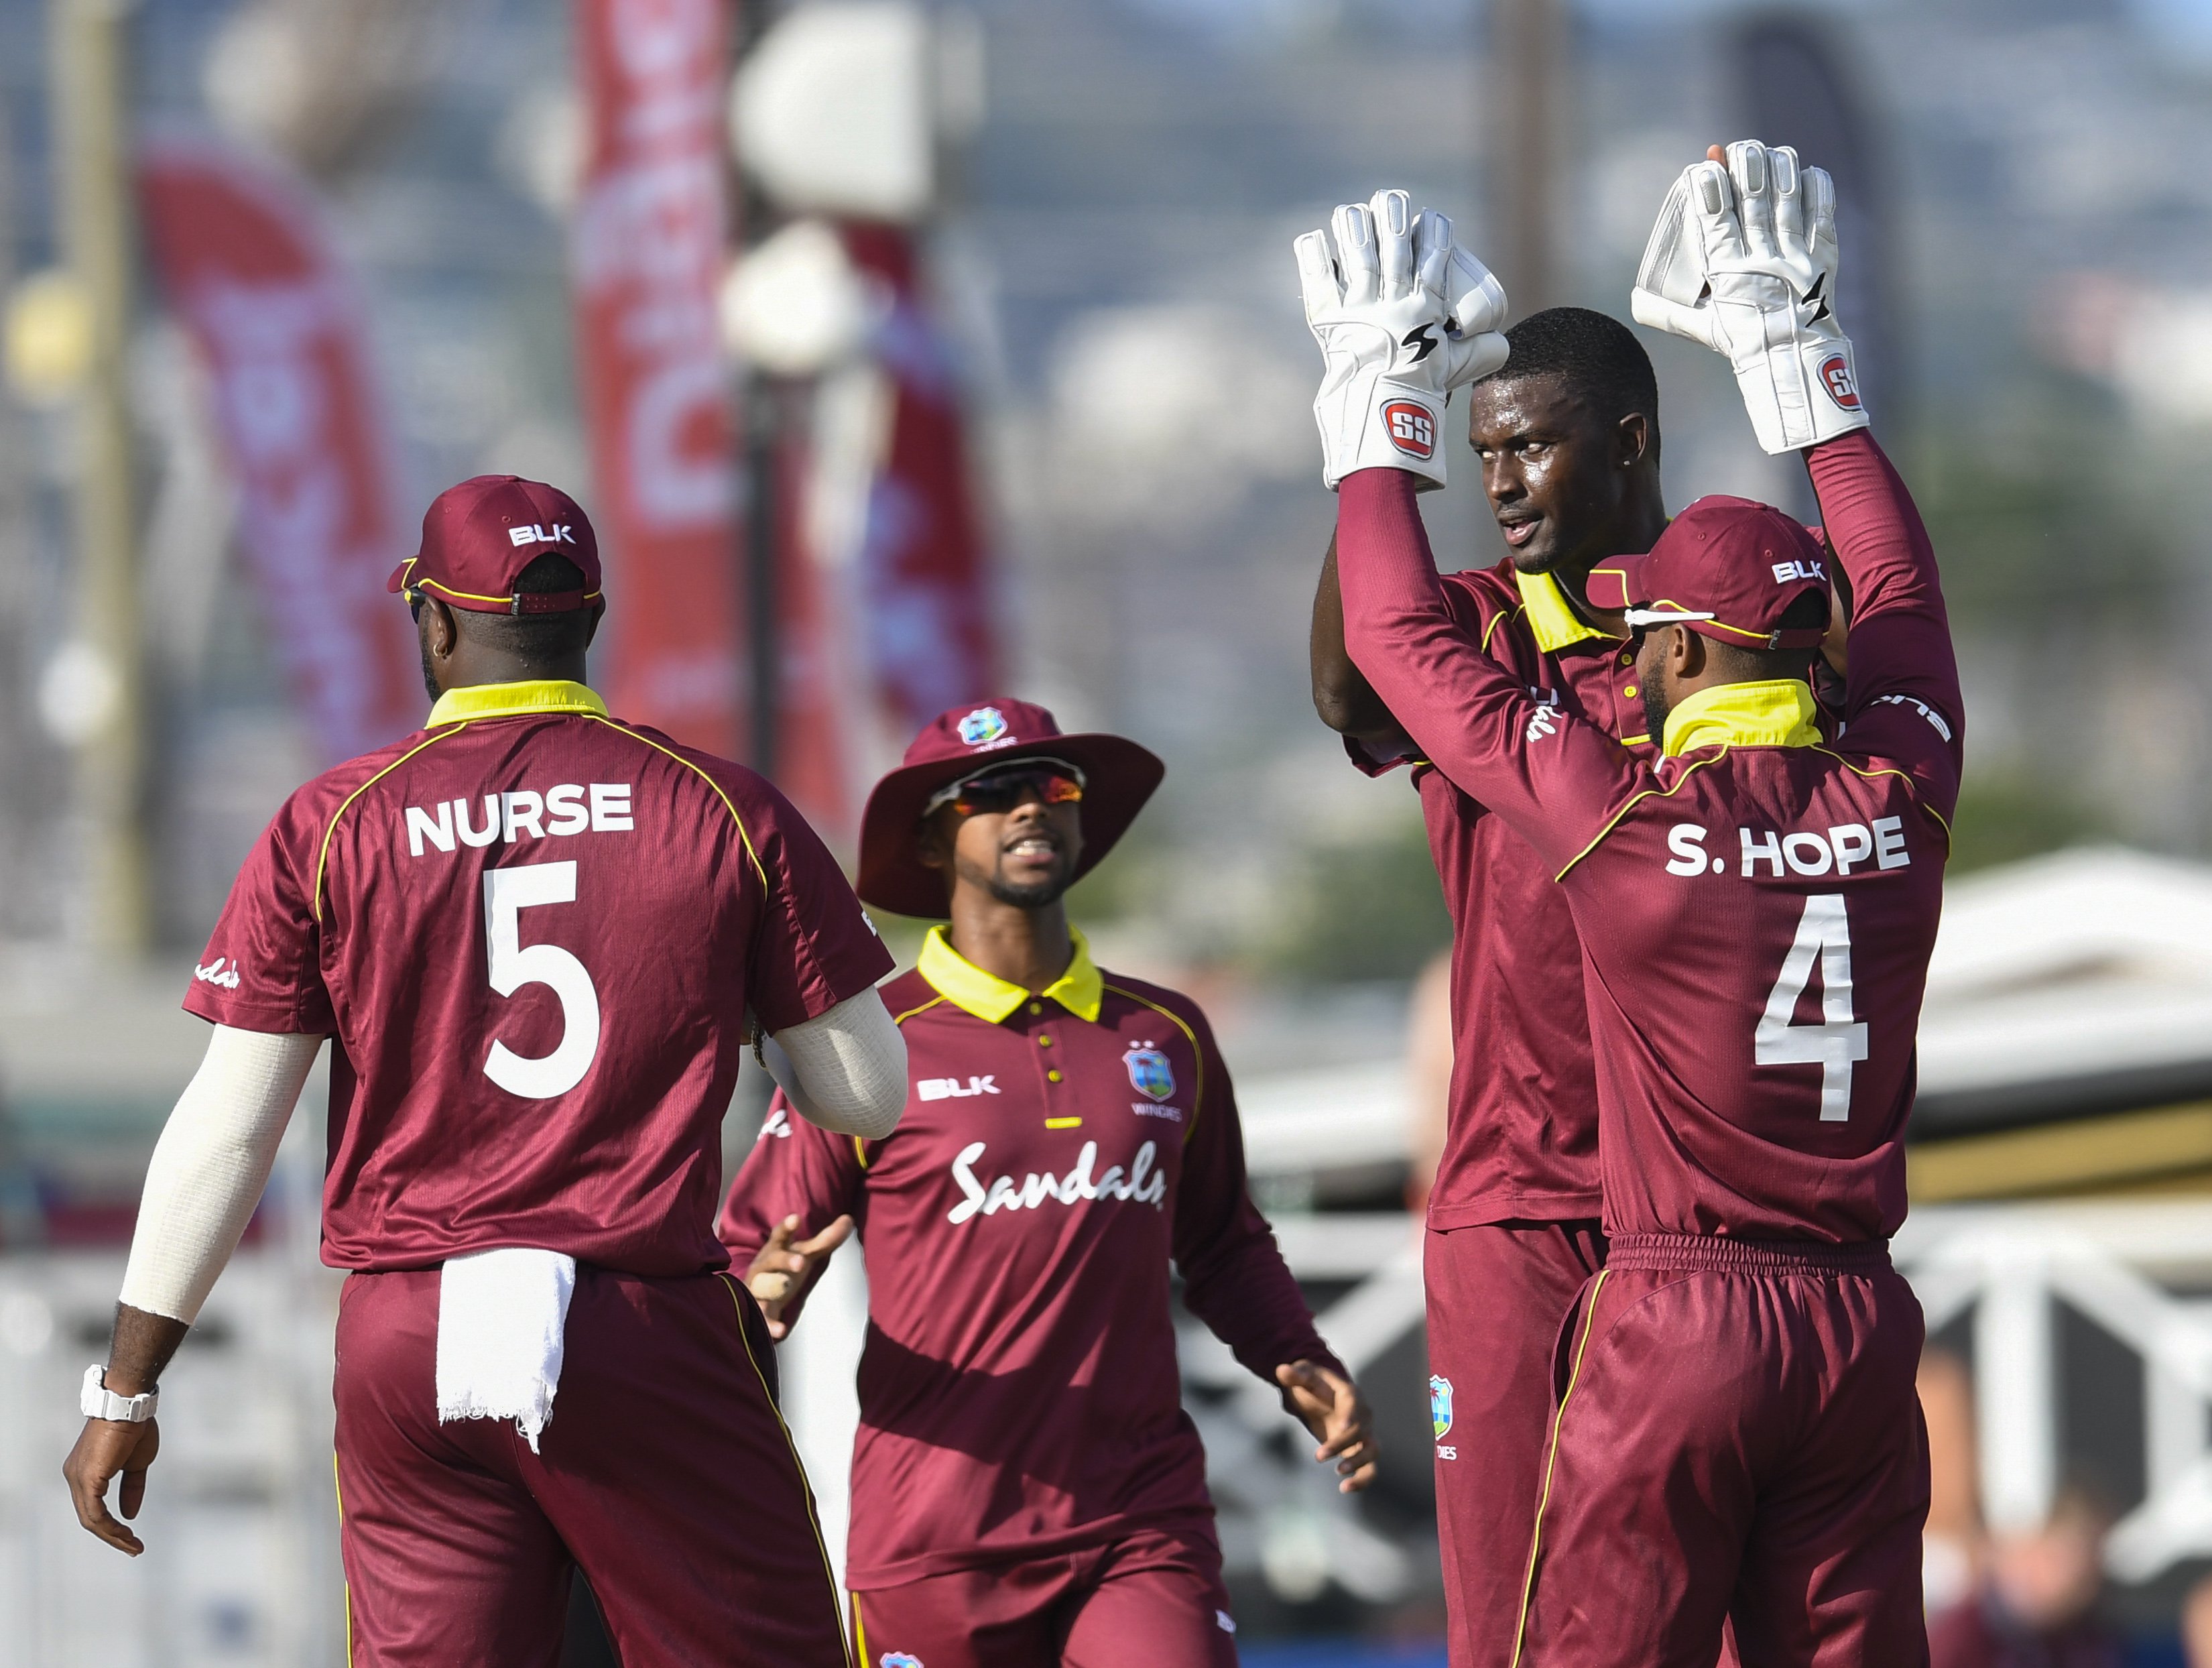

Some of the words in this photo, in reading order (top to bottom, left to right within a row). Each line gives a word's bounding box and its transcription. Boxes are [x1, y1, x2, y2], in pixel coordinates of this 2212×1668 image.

[1392, 412, 1431, 447] SS
[509, 524, 576, 547] BLK
[1772, 560, 1827, 585] BLK
[406, 783, 634, 857] NURSE
[1665, 824, 1725, 876] S.
[1739, 815, 1910, 877] HOPE
[483, 860, 601, 1099] 5
[1755, 894, 1869, 1122] 4
[917, 1075, 1001, 1101] BLK
[947, 1140, 1166, 1225] Sandals
[1436, 1445, 1457, 1460] DIES
